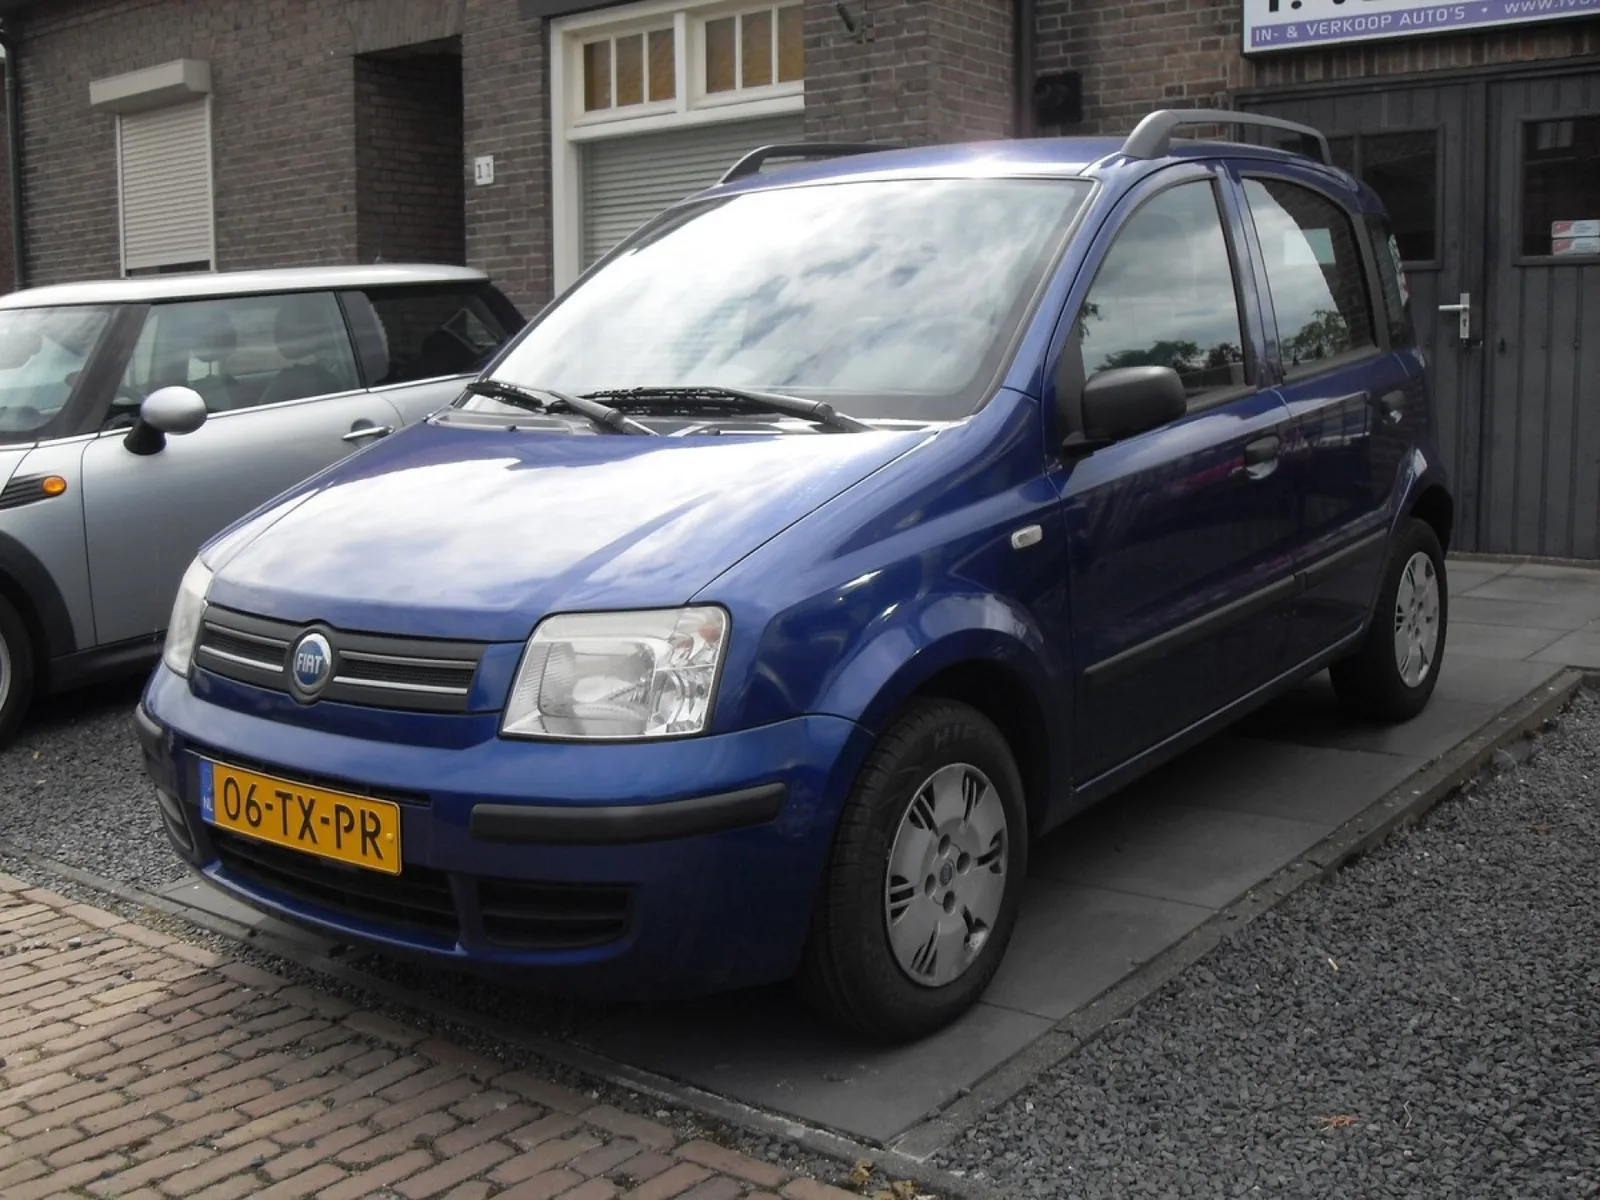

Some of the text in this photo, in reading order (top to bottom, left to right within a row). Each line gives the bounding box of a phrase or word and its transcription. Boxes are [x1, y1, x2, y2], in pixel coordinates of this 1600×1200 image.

[1255, 28, 1279, 42] IN-
[1286, 26, 1298, 39] &
[1306, 14, 1392, 36] VERKOOP
[1400, 6, 1466, 26] AUTO'S
[296, 652, 324, 674] FIAT
[202, 796, 213, 812] NL
[223, 777, 384, 860] 06-TX-PR
